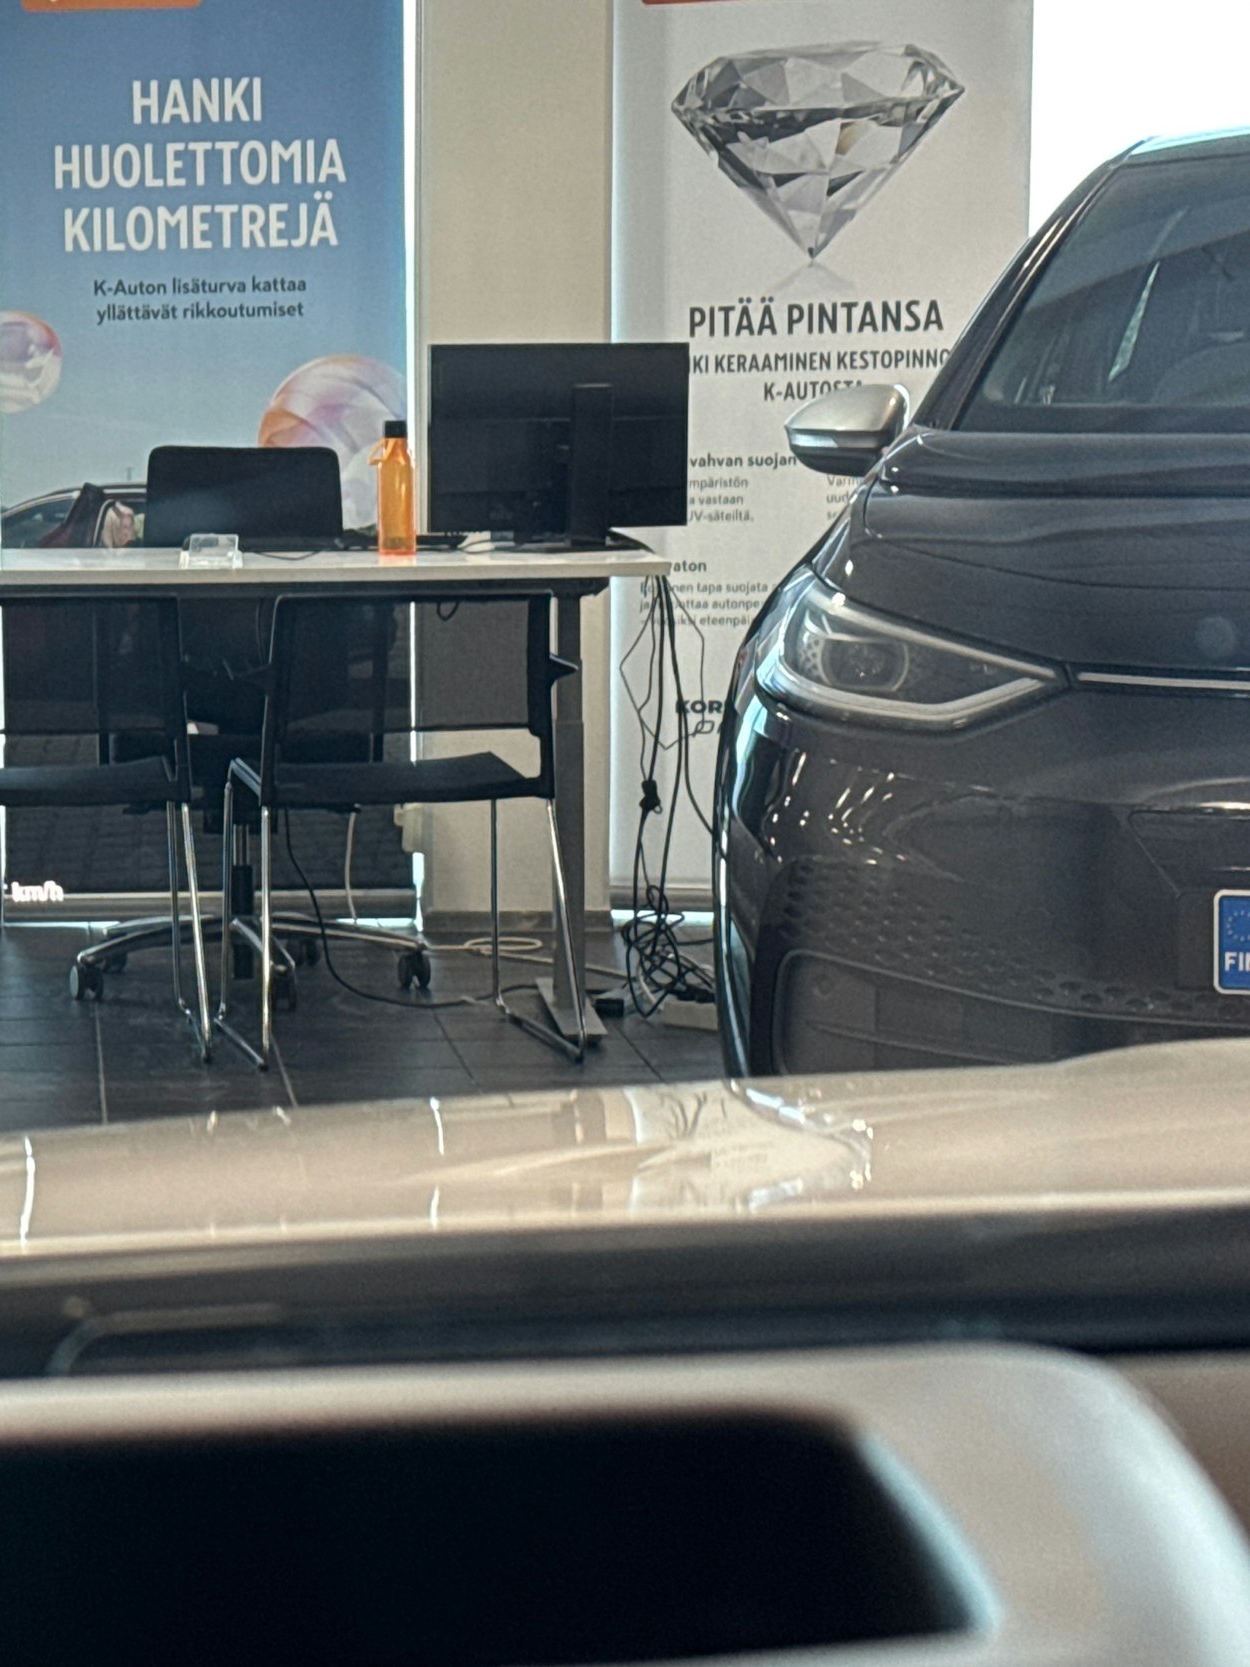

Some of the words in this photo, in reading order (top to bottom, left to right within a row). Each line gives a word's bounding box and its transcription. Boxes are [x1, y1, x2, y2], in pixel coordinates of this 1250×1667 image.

[132, 76, 261, 125] HANKI
[53, 138, 346, 189] HUOLETTOMIA
[63, 191, 338, 252] KILOMETREJÄ
[93, 280, 167, 297] K-Auton
[172, 278, 246, 295] lisäturva
[251, 276, 306, 293] kattaa
[96, 303, 178, 323] yllättävät
[183, 302, 304, 320] rikkoutumiset
[689, 296, 777, 338] PITÄÄ
[787, 300, 943, 335] PINTANSA
[689, 354, 709, 374] KI
[714, 351, 831, 374] KERAAMINEN
[764, 379, 863, 401] K-AUTO
[690, 452, 743, 467] vahvan
[747, 452, 797, 469] suojan
[699, 494, 744, 505] vastaan
[671, 560, 707, 572] aton
[697, 582, 722, 595] tapa
[726, 581, 768, 596] suojata
[712, 599, 763, 611] autonpe
[11, 880, 64, 902] km/h
